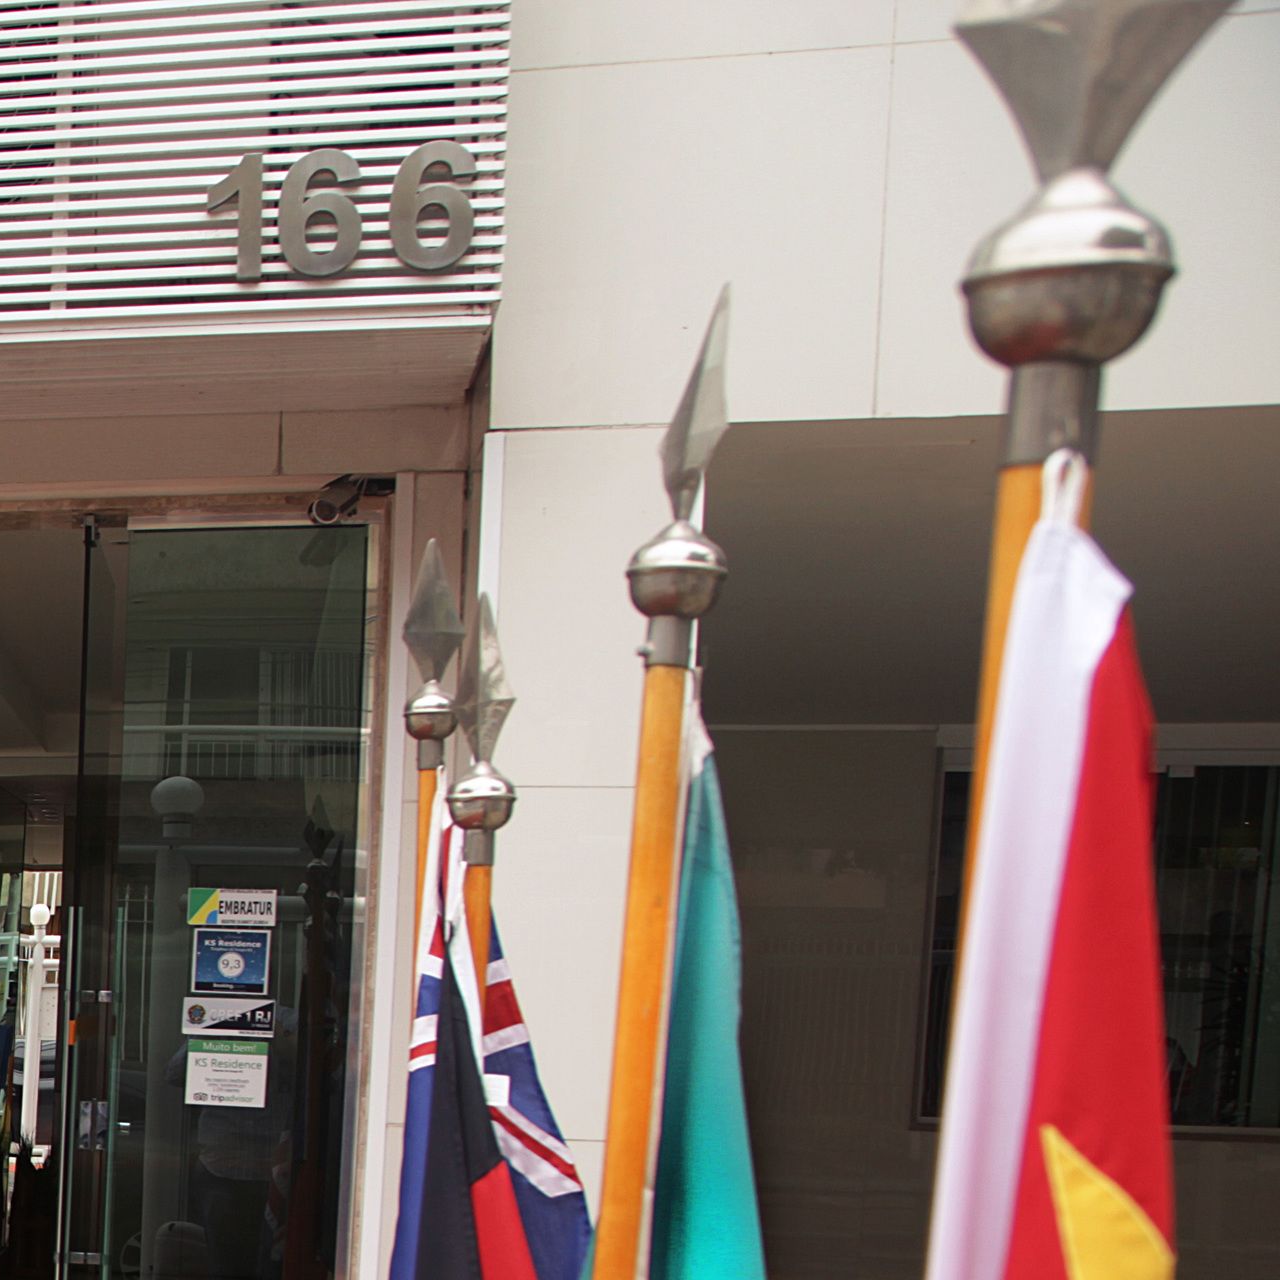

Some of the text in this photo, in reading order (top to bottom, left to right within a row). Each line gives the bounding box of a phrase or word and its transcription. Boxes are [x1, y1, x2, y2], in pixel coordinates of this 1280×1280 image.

[207, 140, 477, 283] 166
[219, 901, 272, 915] EMBRATUR
[204, 939, 262, 948] KS Residence
[256, 1011, 272, 1023] RJ
[202, 1042, 256, 1052] Muito bem!
[195, 1057, 262, 1069] KS Residence
[211, 1095, 255, 1103] tripadvisor
